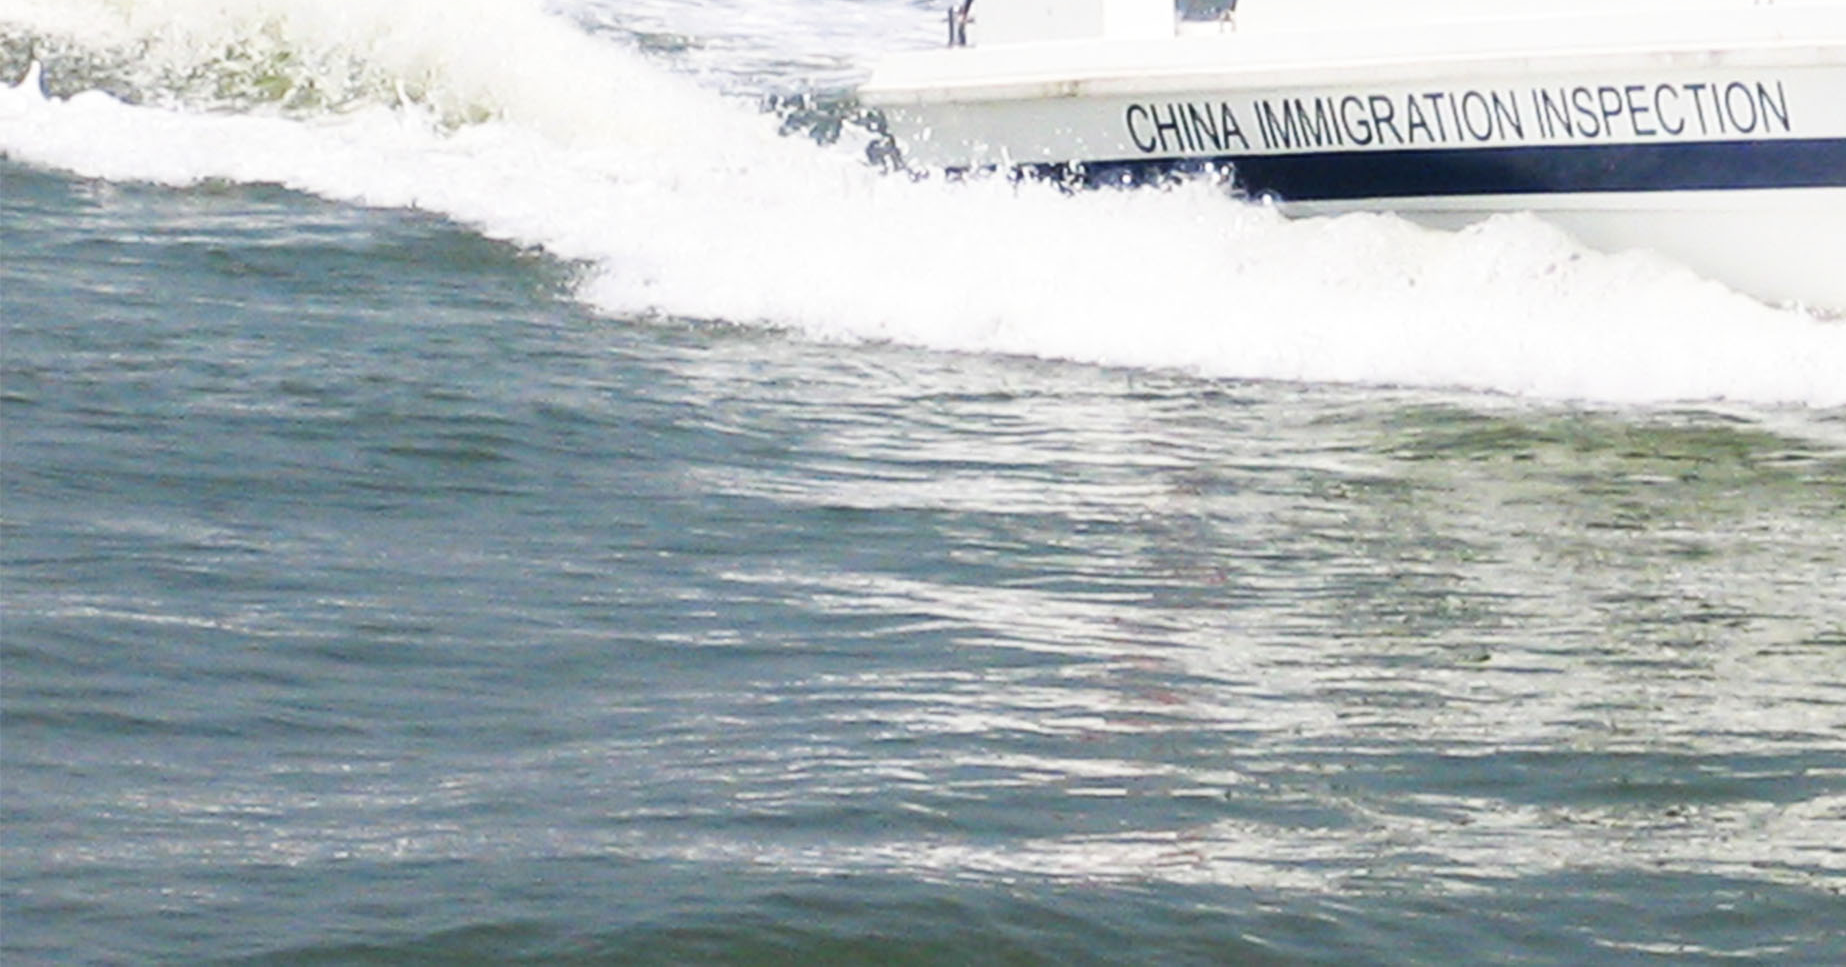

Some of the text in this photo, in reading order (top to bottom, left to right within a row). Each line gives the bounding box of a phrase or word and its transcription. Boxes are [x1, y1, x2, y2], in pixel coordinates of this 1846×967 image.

[1126, 80, 1791, 153] CHINA IMMIGRATION INSPECTION
